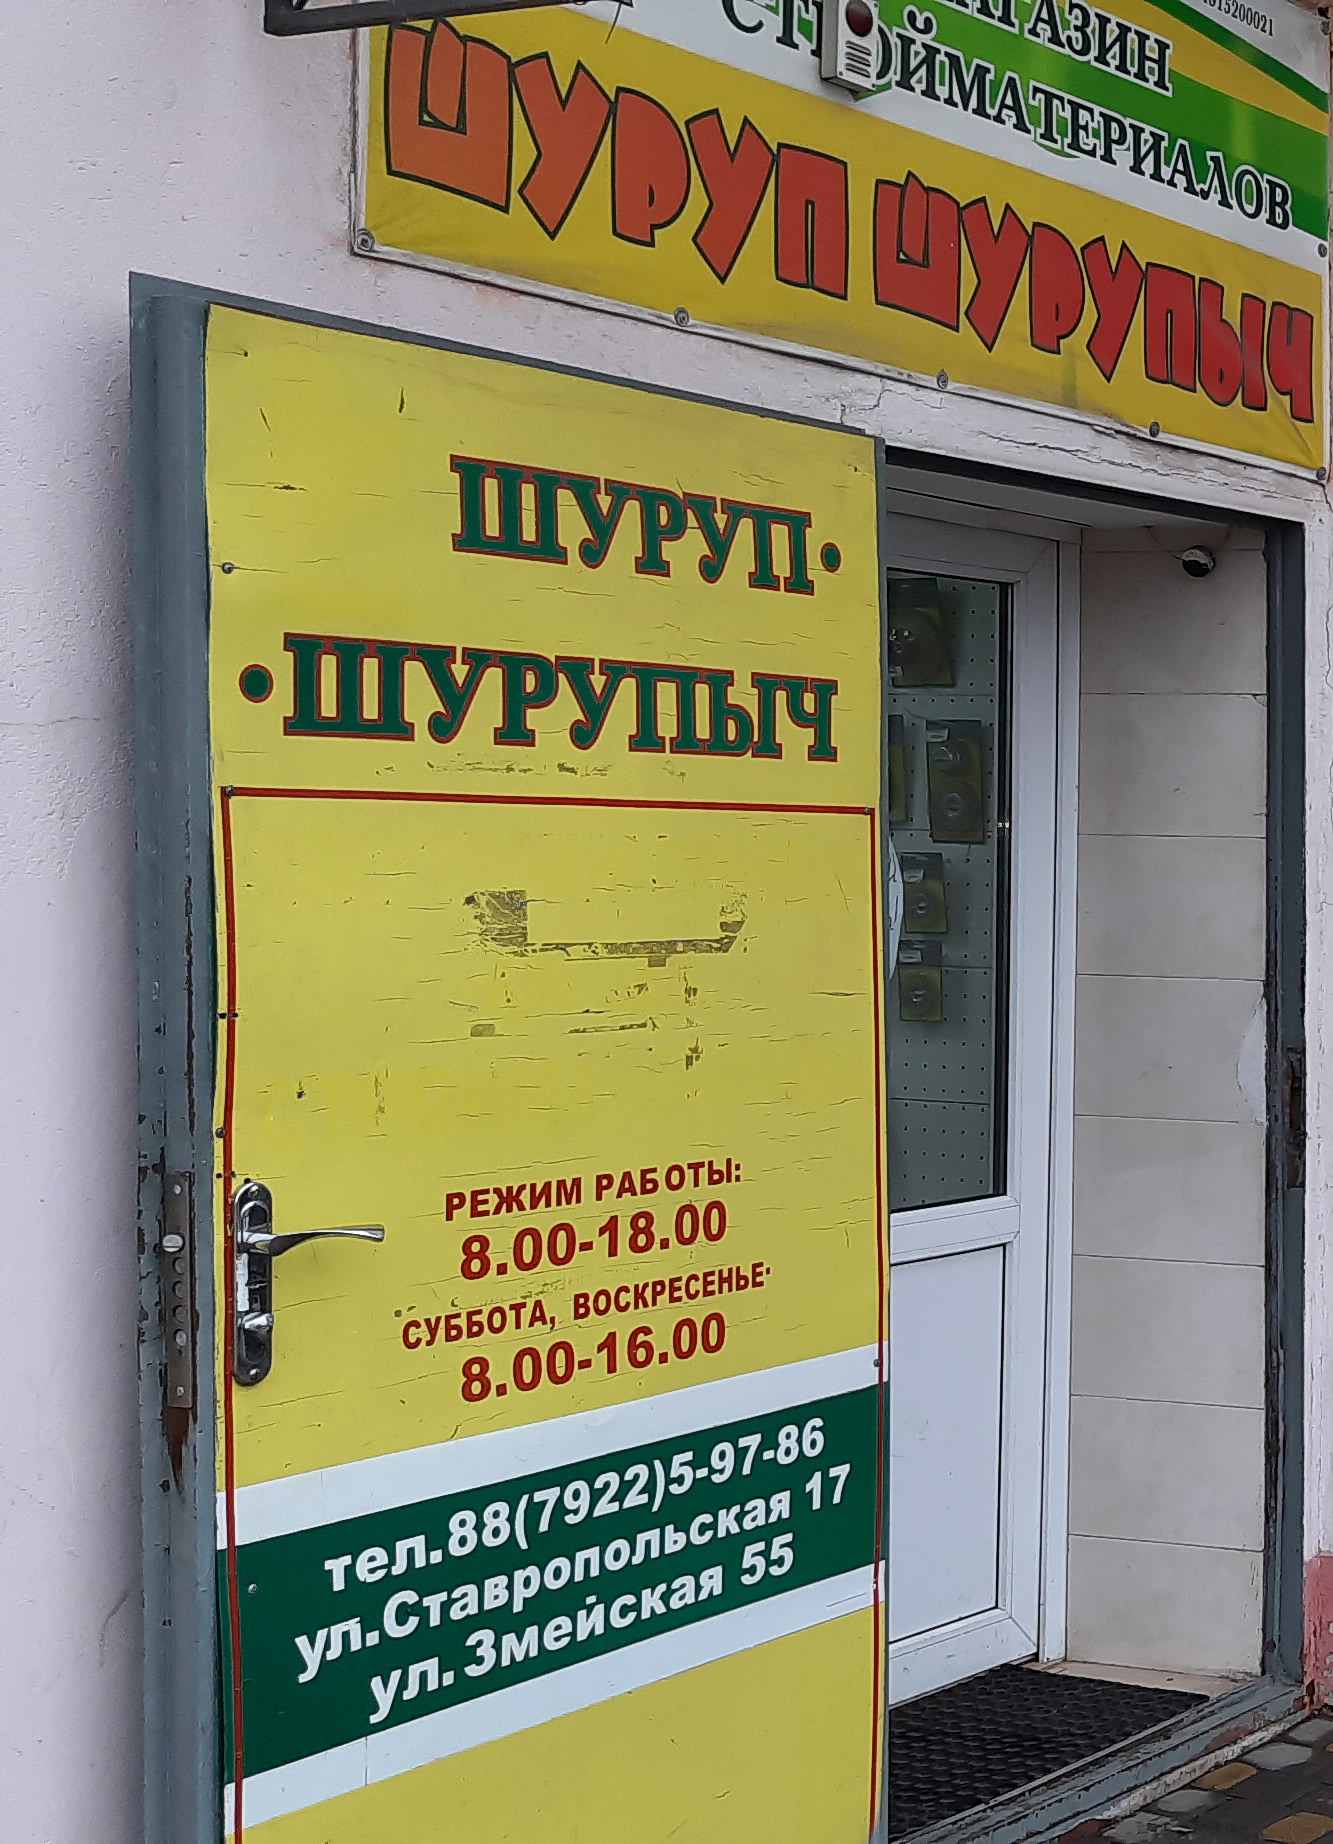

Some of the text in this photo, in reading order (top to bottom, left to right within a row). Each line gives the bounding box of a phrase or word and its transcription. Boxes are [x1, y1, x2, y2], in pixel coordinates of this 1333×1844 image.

[932, 0, 1170, 93] АЗИН
[1202, 0, 1274, 37] 15200021
[385, 18, 1314, 423] ШУРУП ШУРУПЫЧ
[445, 1157, 742, 1221] РЕЖИМ РАБОТЫ:
[460, 1200, 728, 1280] 8.00-18.00
[402, 1299, 556, 1350] СУББОТА,
[461, 1311, 727, 1403] 8.00-16.00
[804, 1463, 852, 1511] 17
[463, 1562, 723, 1678] Змейская
[739, 1533, 795, 1587] 55
